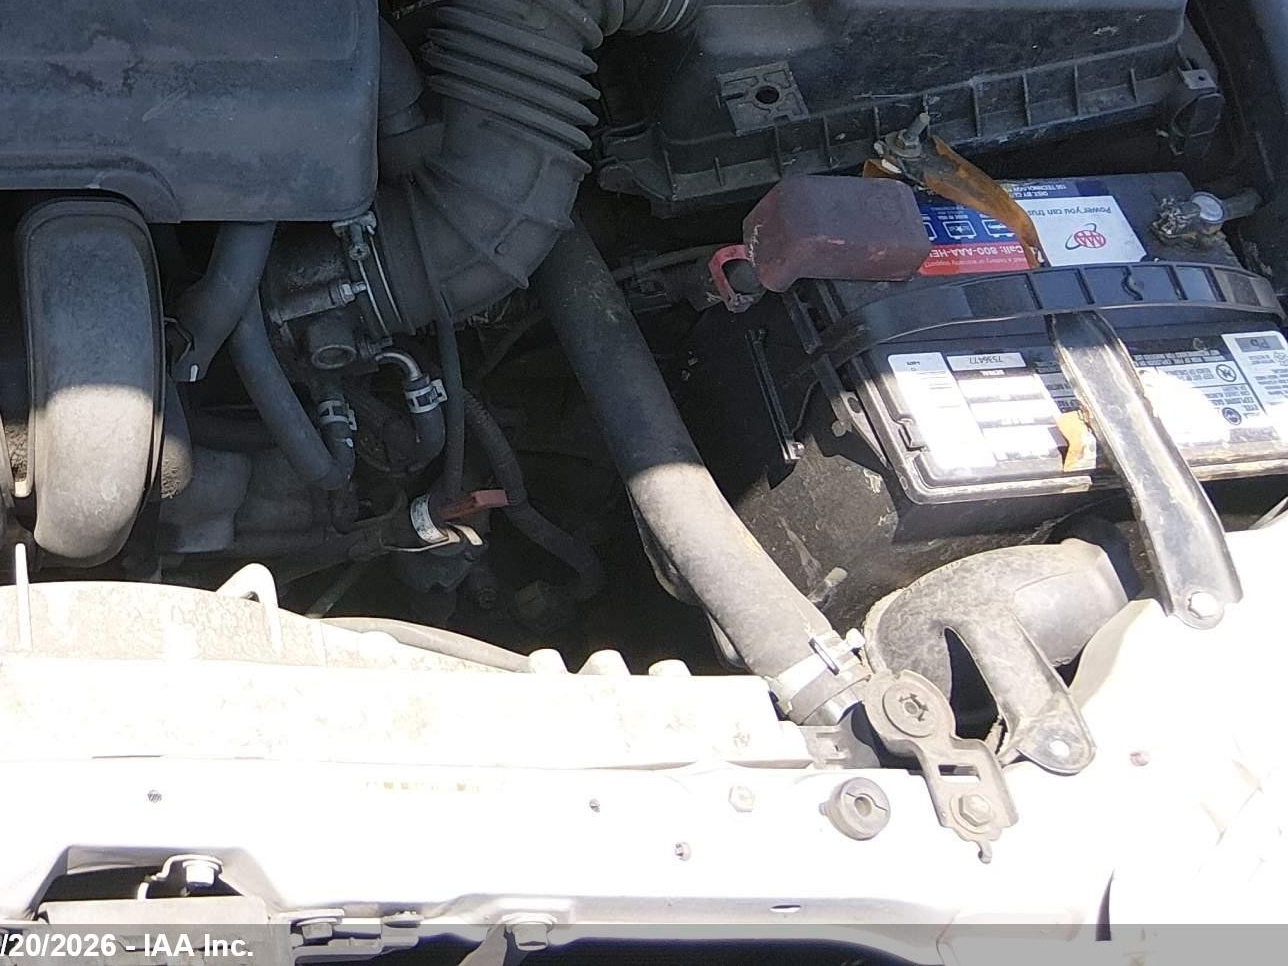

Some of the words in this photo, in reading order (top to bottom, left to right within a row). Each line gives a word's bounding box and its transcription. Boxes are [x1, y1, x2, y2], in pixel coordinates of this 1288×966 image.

[1027, 208, 1045, 217] trus
[1063, 205, 1082, 215] you
[1083, 205, 1111, 215] Power
[928, 246, 998, 257] 800-AAA-HE
[998, 244, 1024, 255] Call:
